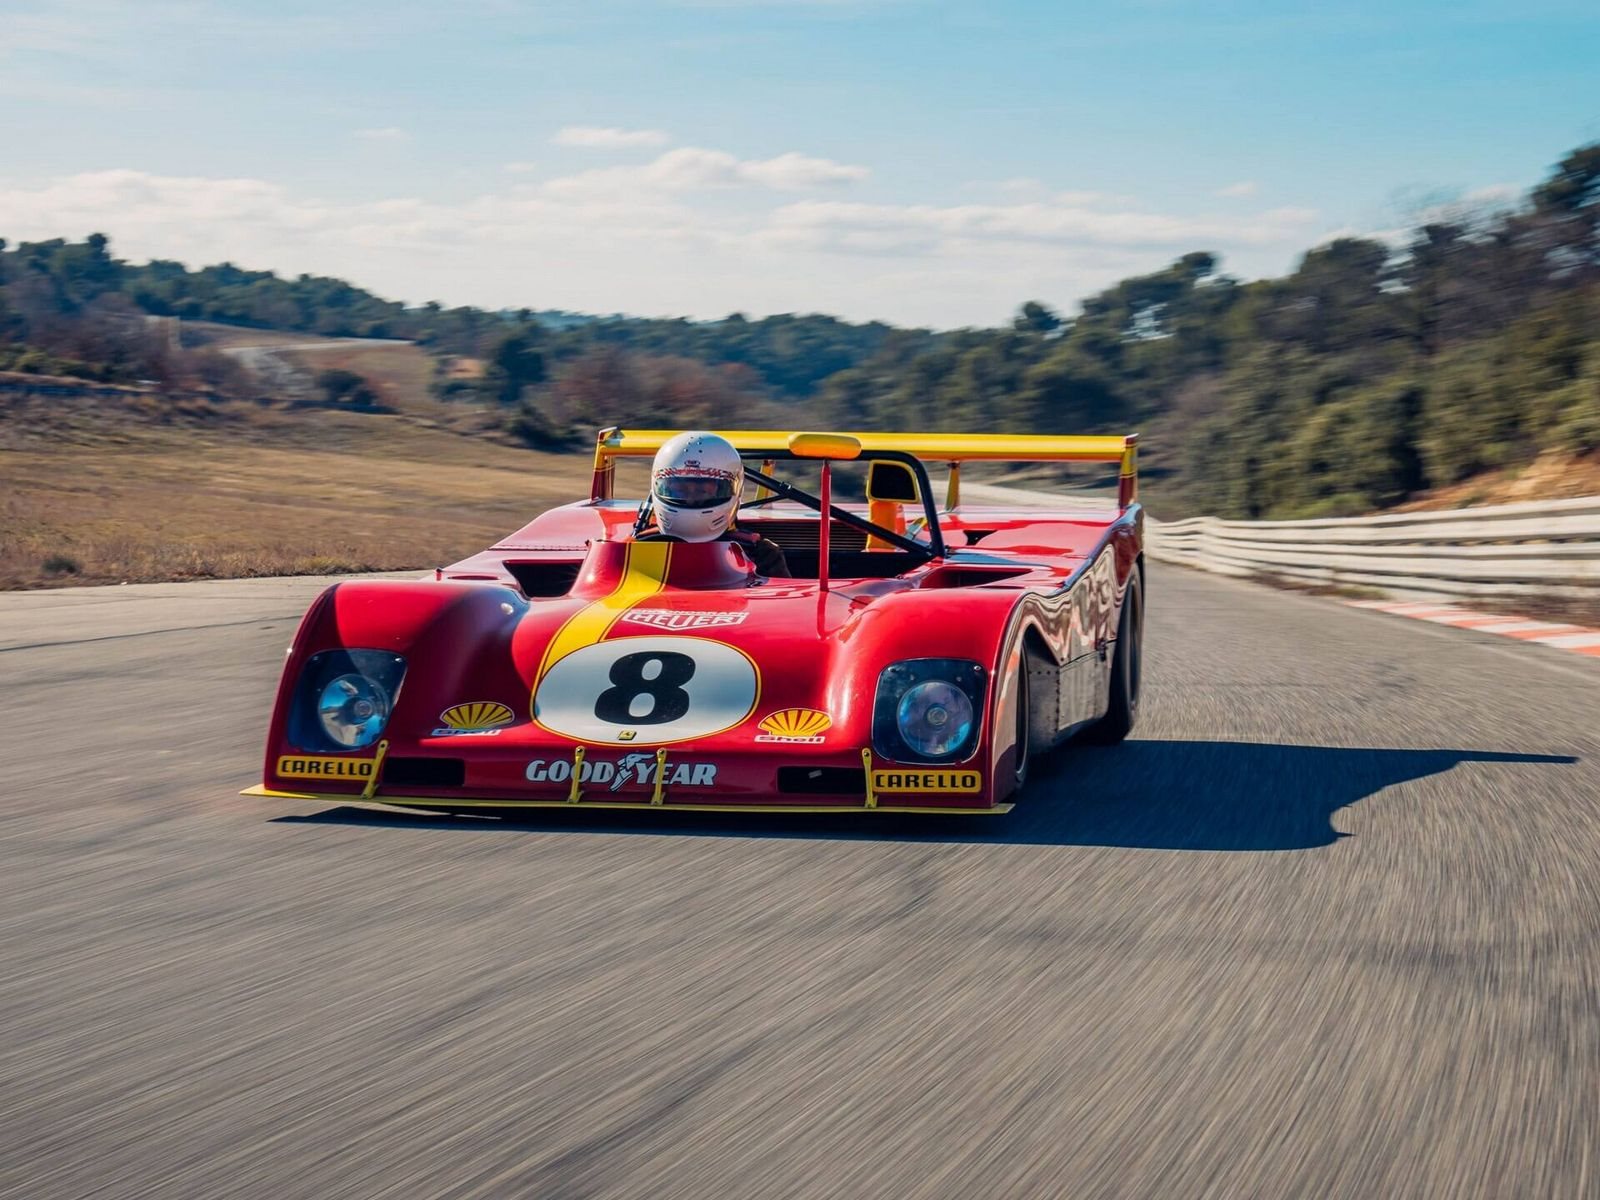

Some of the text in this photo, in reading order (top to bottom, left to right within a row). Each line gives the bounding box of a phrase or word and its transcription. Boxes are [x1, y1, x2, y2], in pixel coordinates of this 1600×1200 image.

[632, 612, 736, 628] HEUER
[594, 651, 696, 725] 8
[281, 759, 373, 776] CARELLO
[875, 774, 977, 788] CARELLO
